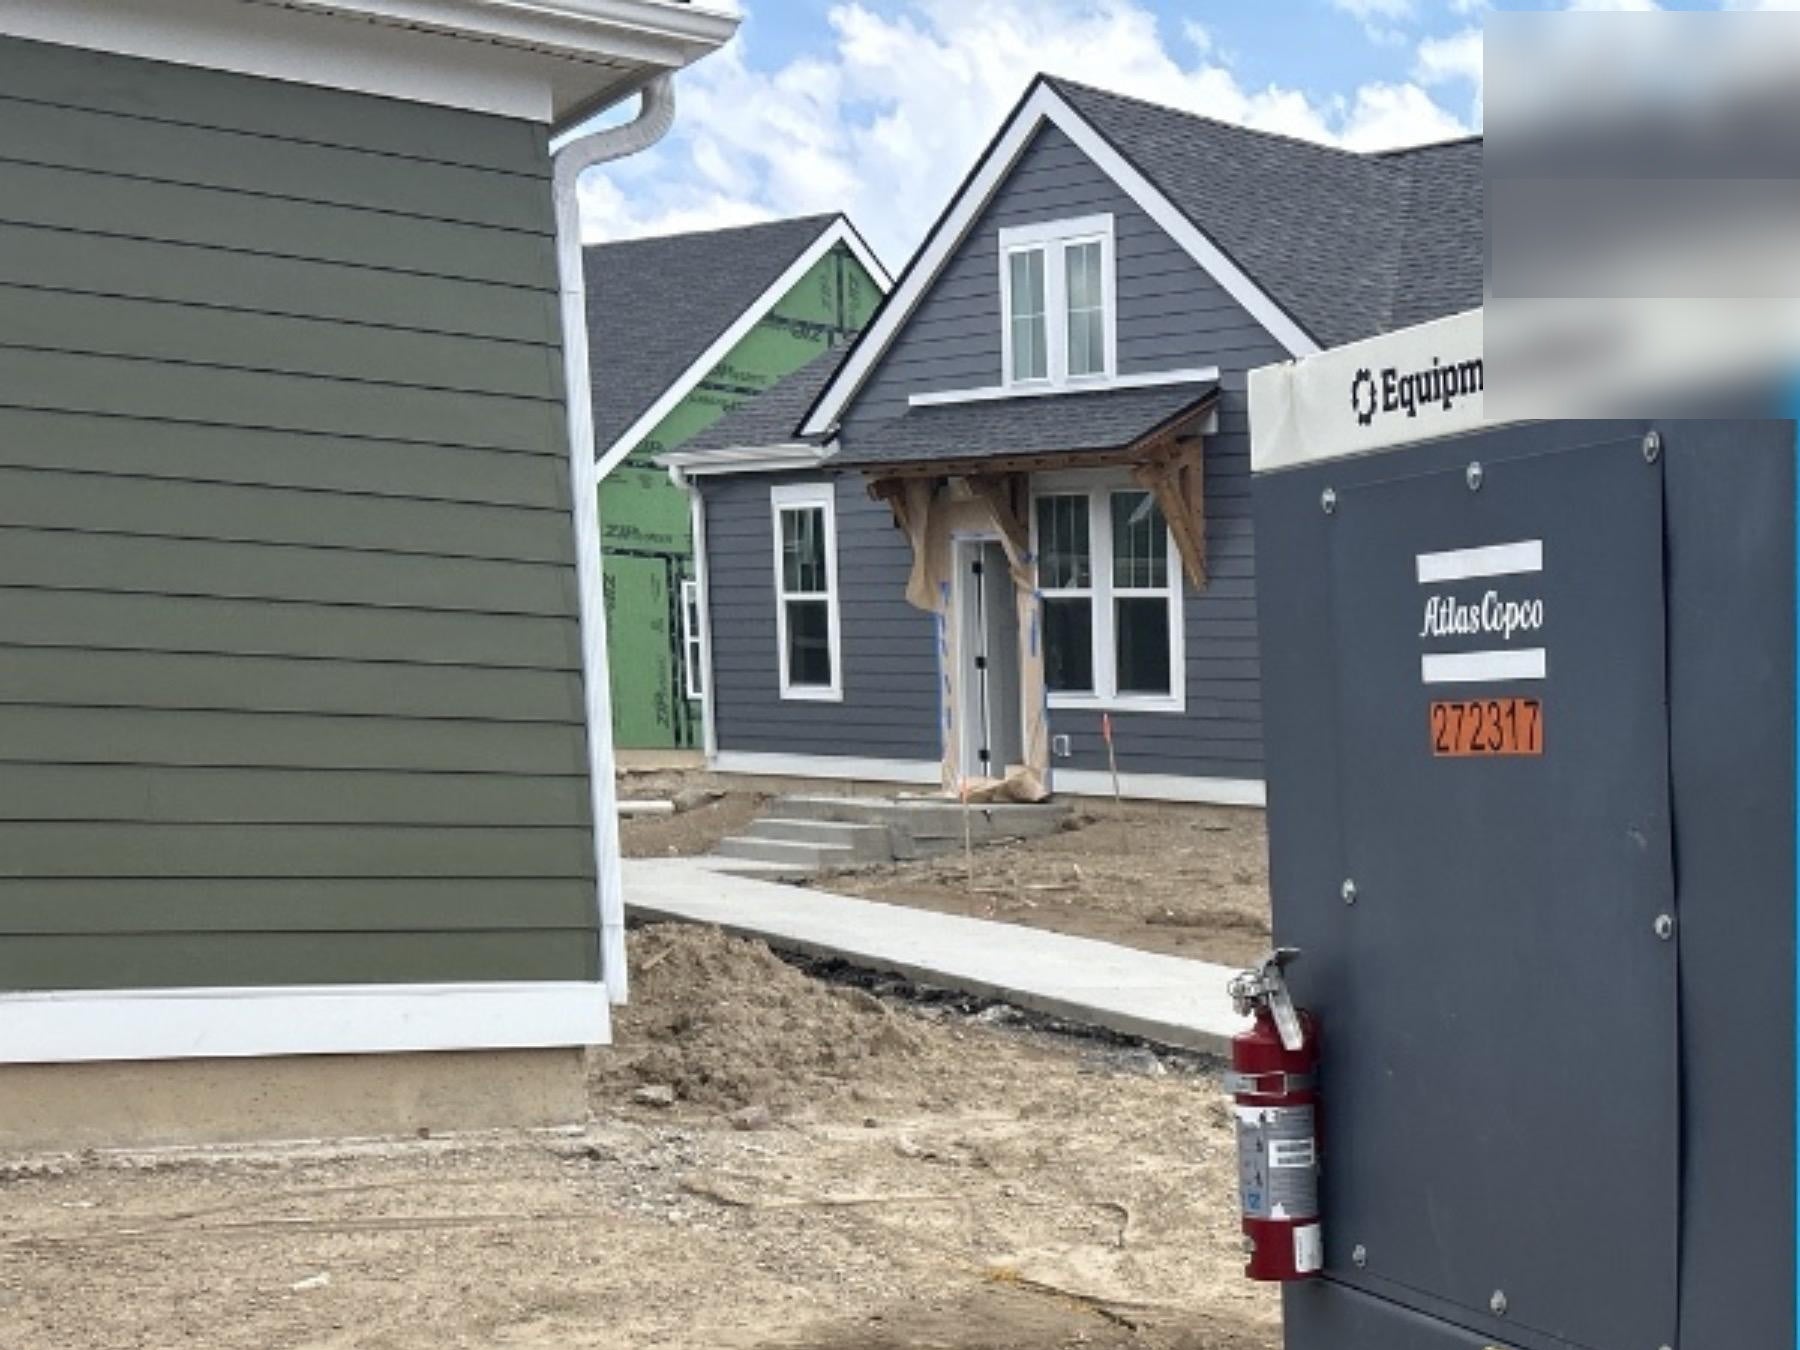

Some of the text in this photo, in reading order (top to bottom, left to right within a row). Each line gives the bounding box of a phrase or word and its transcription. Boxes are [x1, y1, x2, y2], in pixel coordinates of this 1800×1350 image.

[1419, 590, 1543, 640] Atlas Copco
[1433, 700, 1540, 752] 272317
